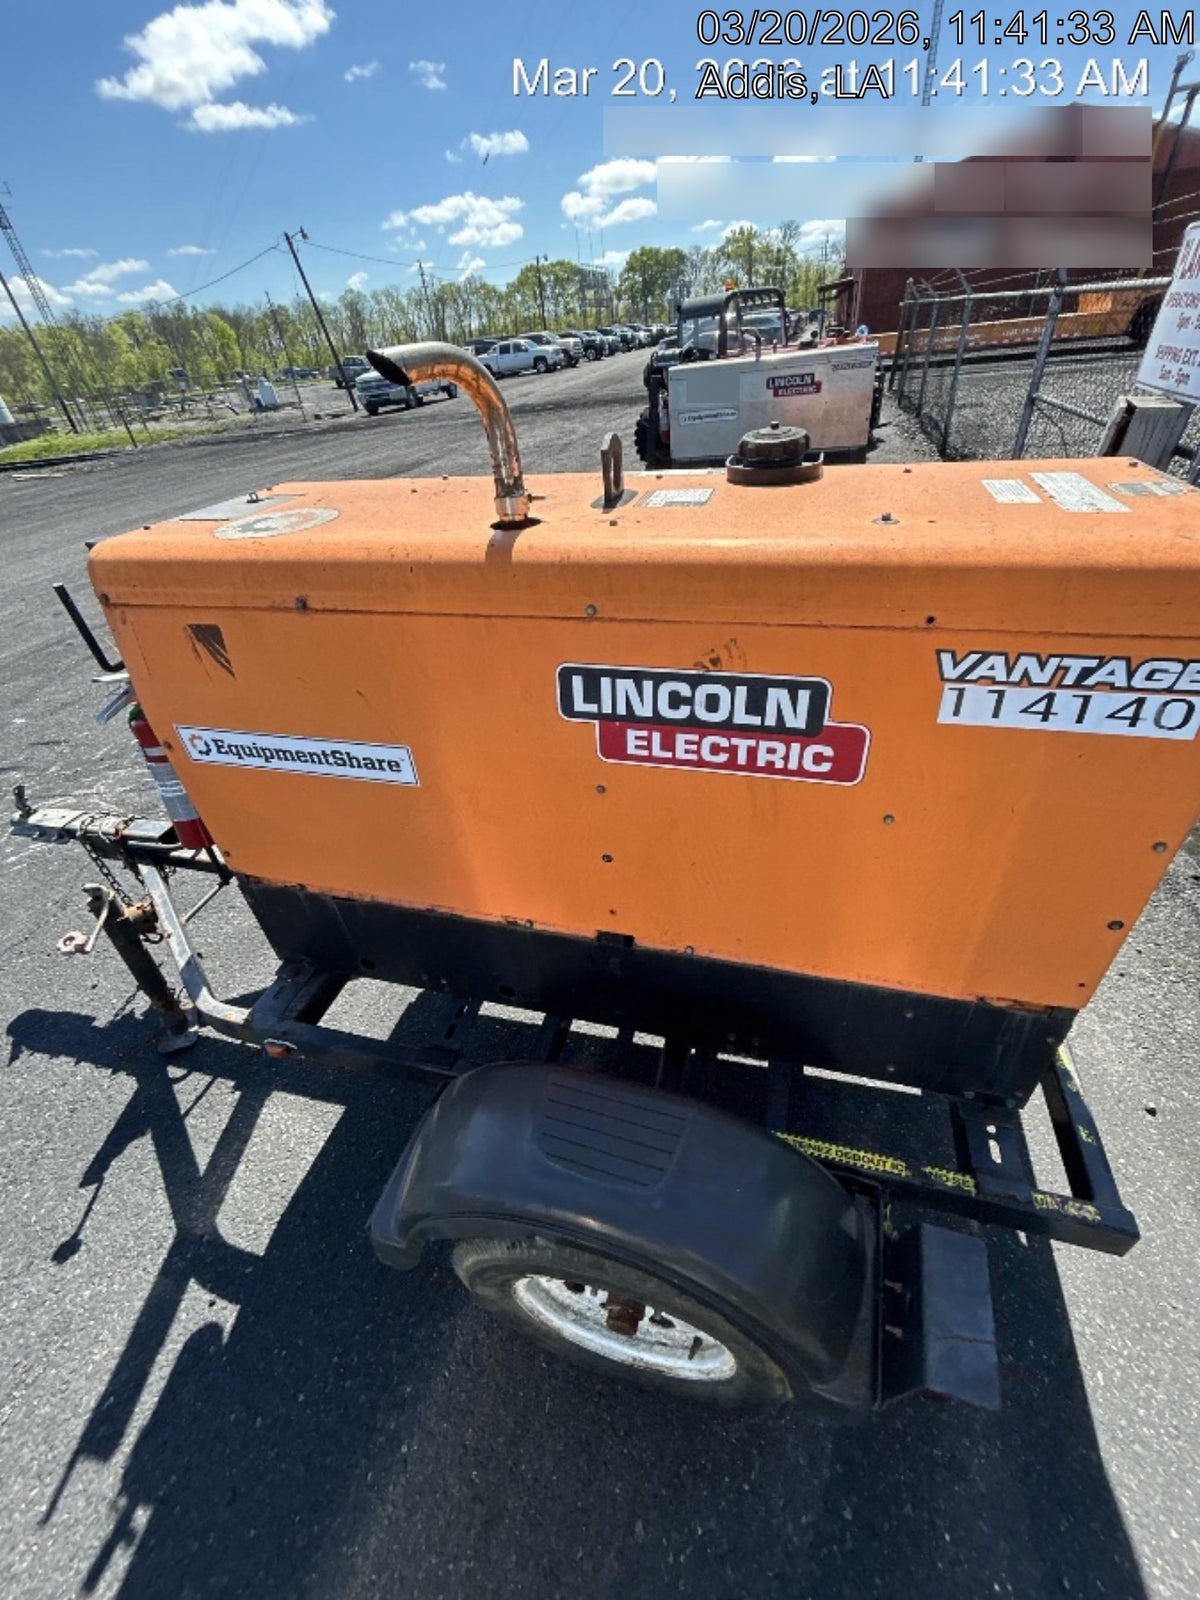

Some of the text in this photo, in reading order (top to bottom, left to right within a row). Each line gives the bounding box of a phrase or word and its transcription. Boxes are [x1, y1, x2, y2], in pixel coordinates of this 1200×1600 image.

[769, 374, 813, 388] LINCOLN
[571, 674, 812, 730] LINCOLN
[948, 686, 1197, 731] 114140
[210, 738, 403, 773] EquipmentShare
[625, 727, 835, 773] ELECTRIC
[834, 1149, 887, 1171] DEBOUT
